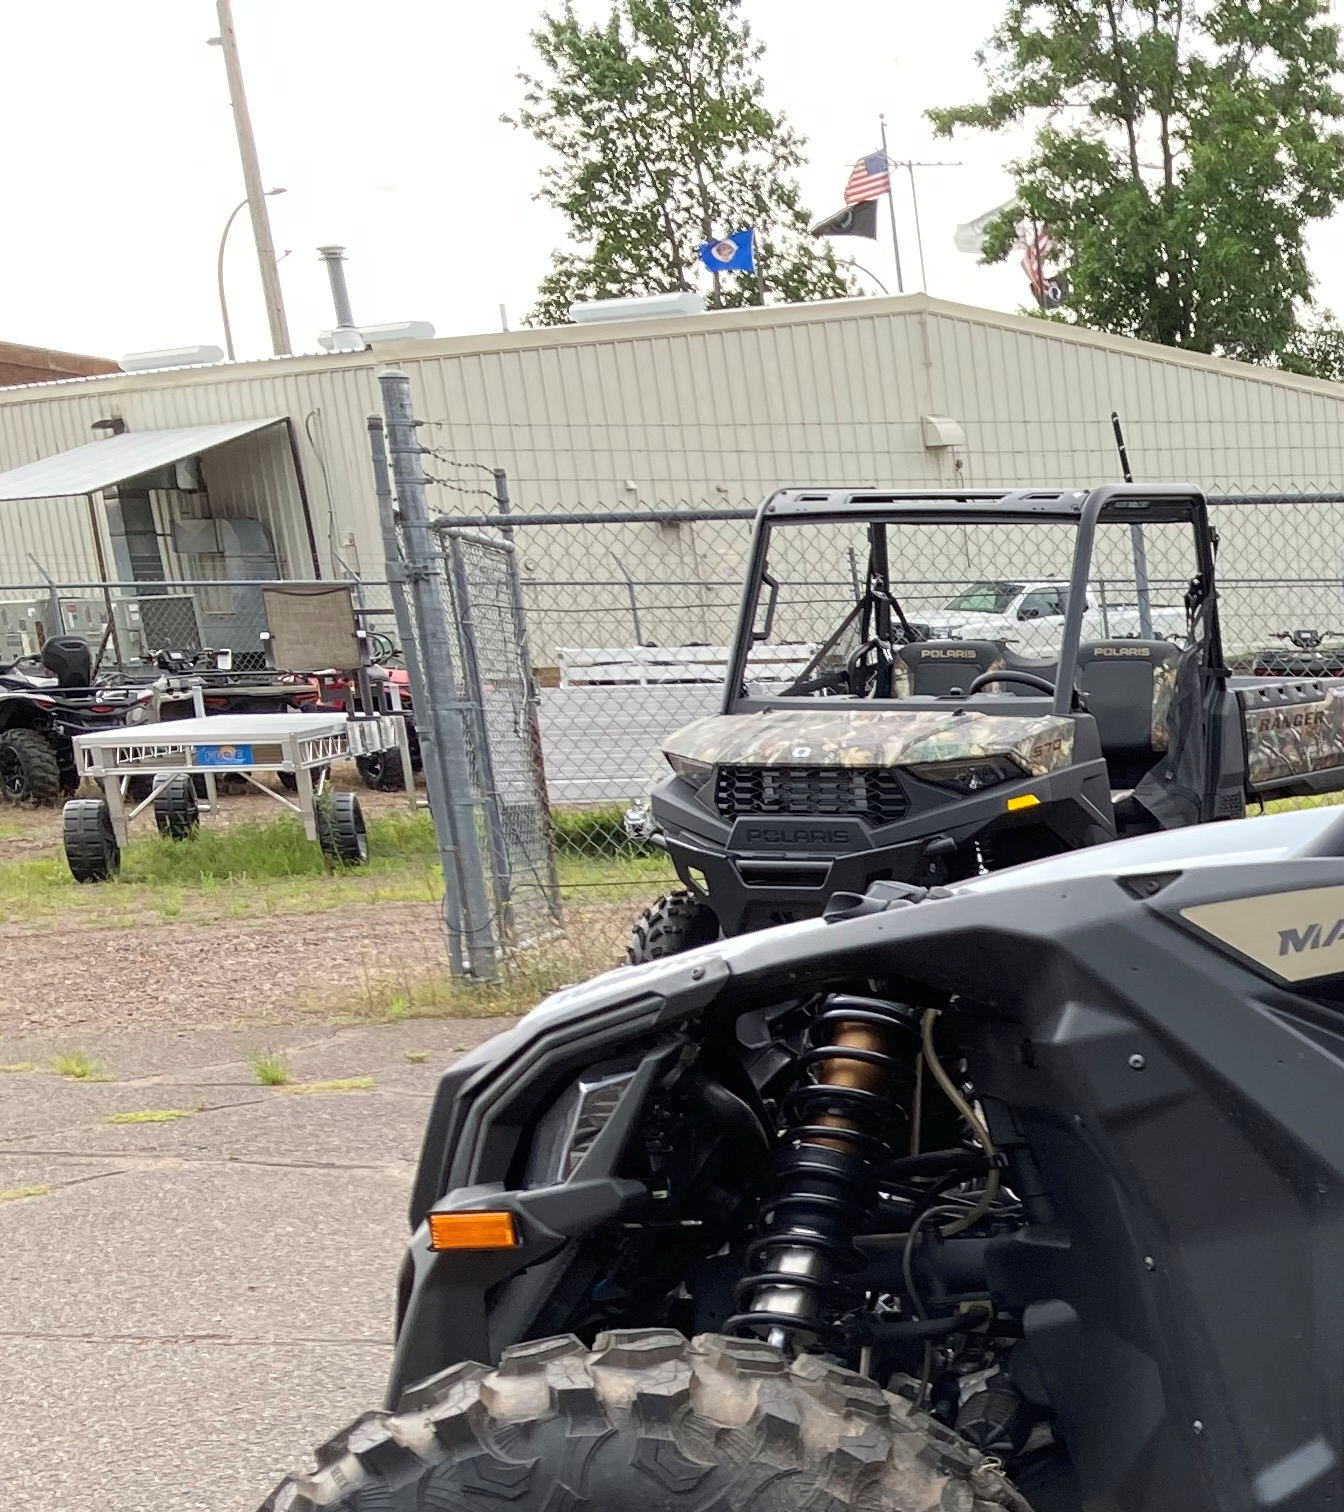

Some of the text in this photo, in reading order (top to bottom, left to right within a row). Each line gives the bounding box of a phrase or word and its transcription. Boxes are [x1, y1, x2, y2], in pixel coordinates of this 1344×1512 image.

[921, 649, 977, 659] POLARIS
[1094, 647, 1150, 657] POLARIS
[1260, 711, 1325, 732] RANGER
[746, 828, 850, 844] POLARIS
